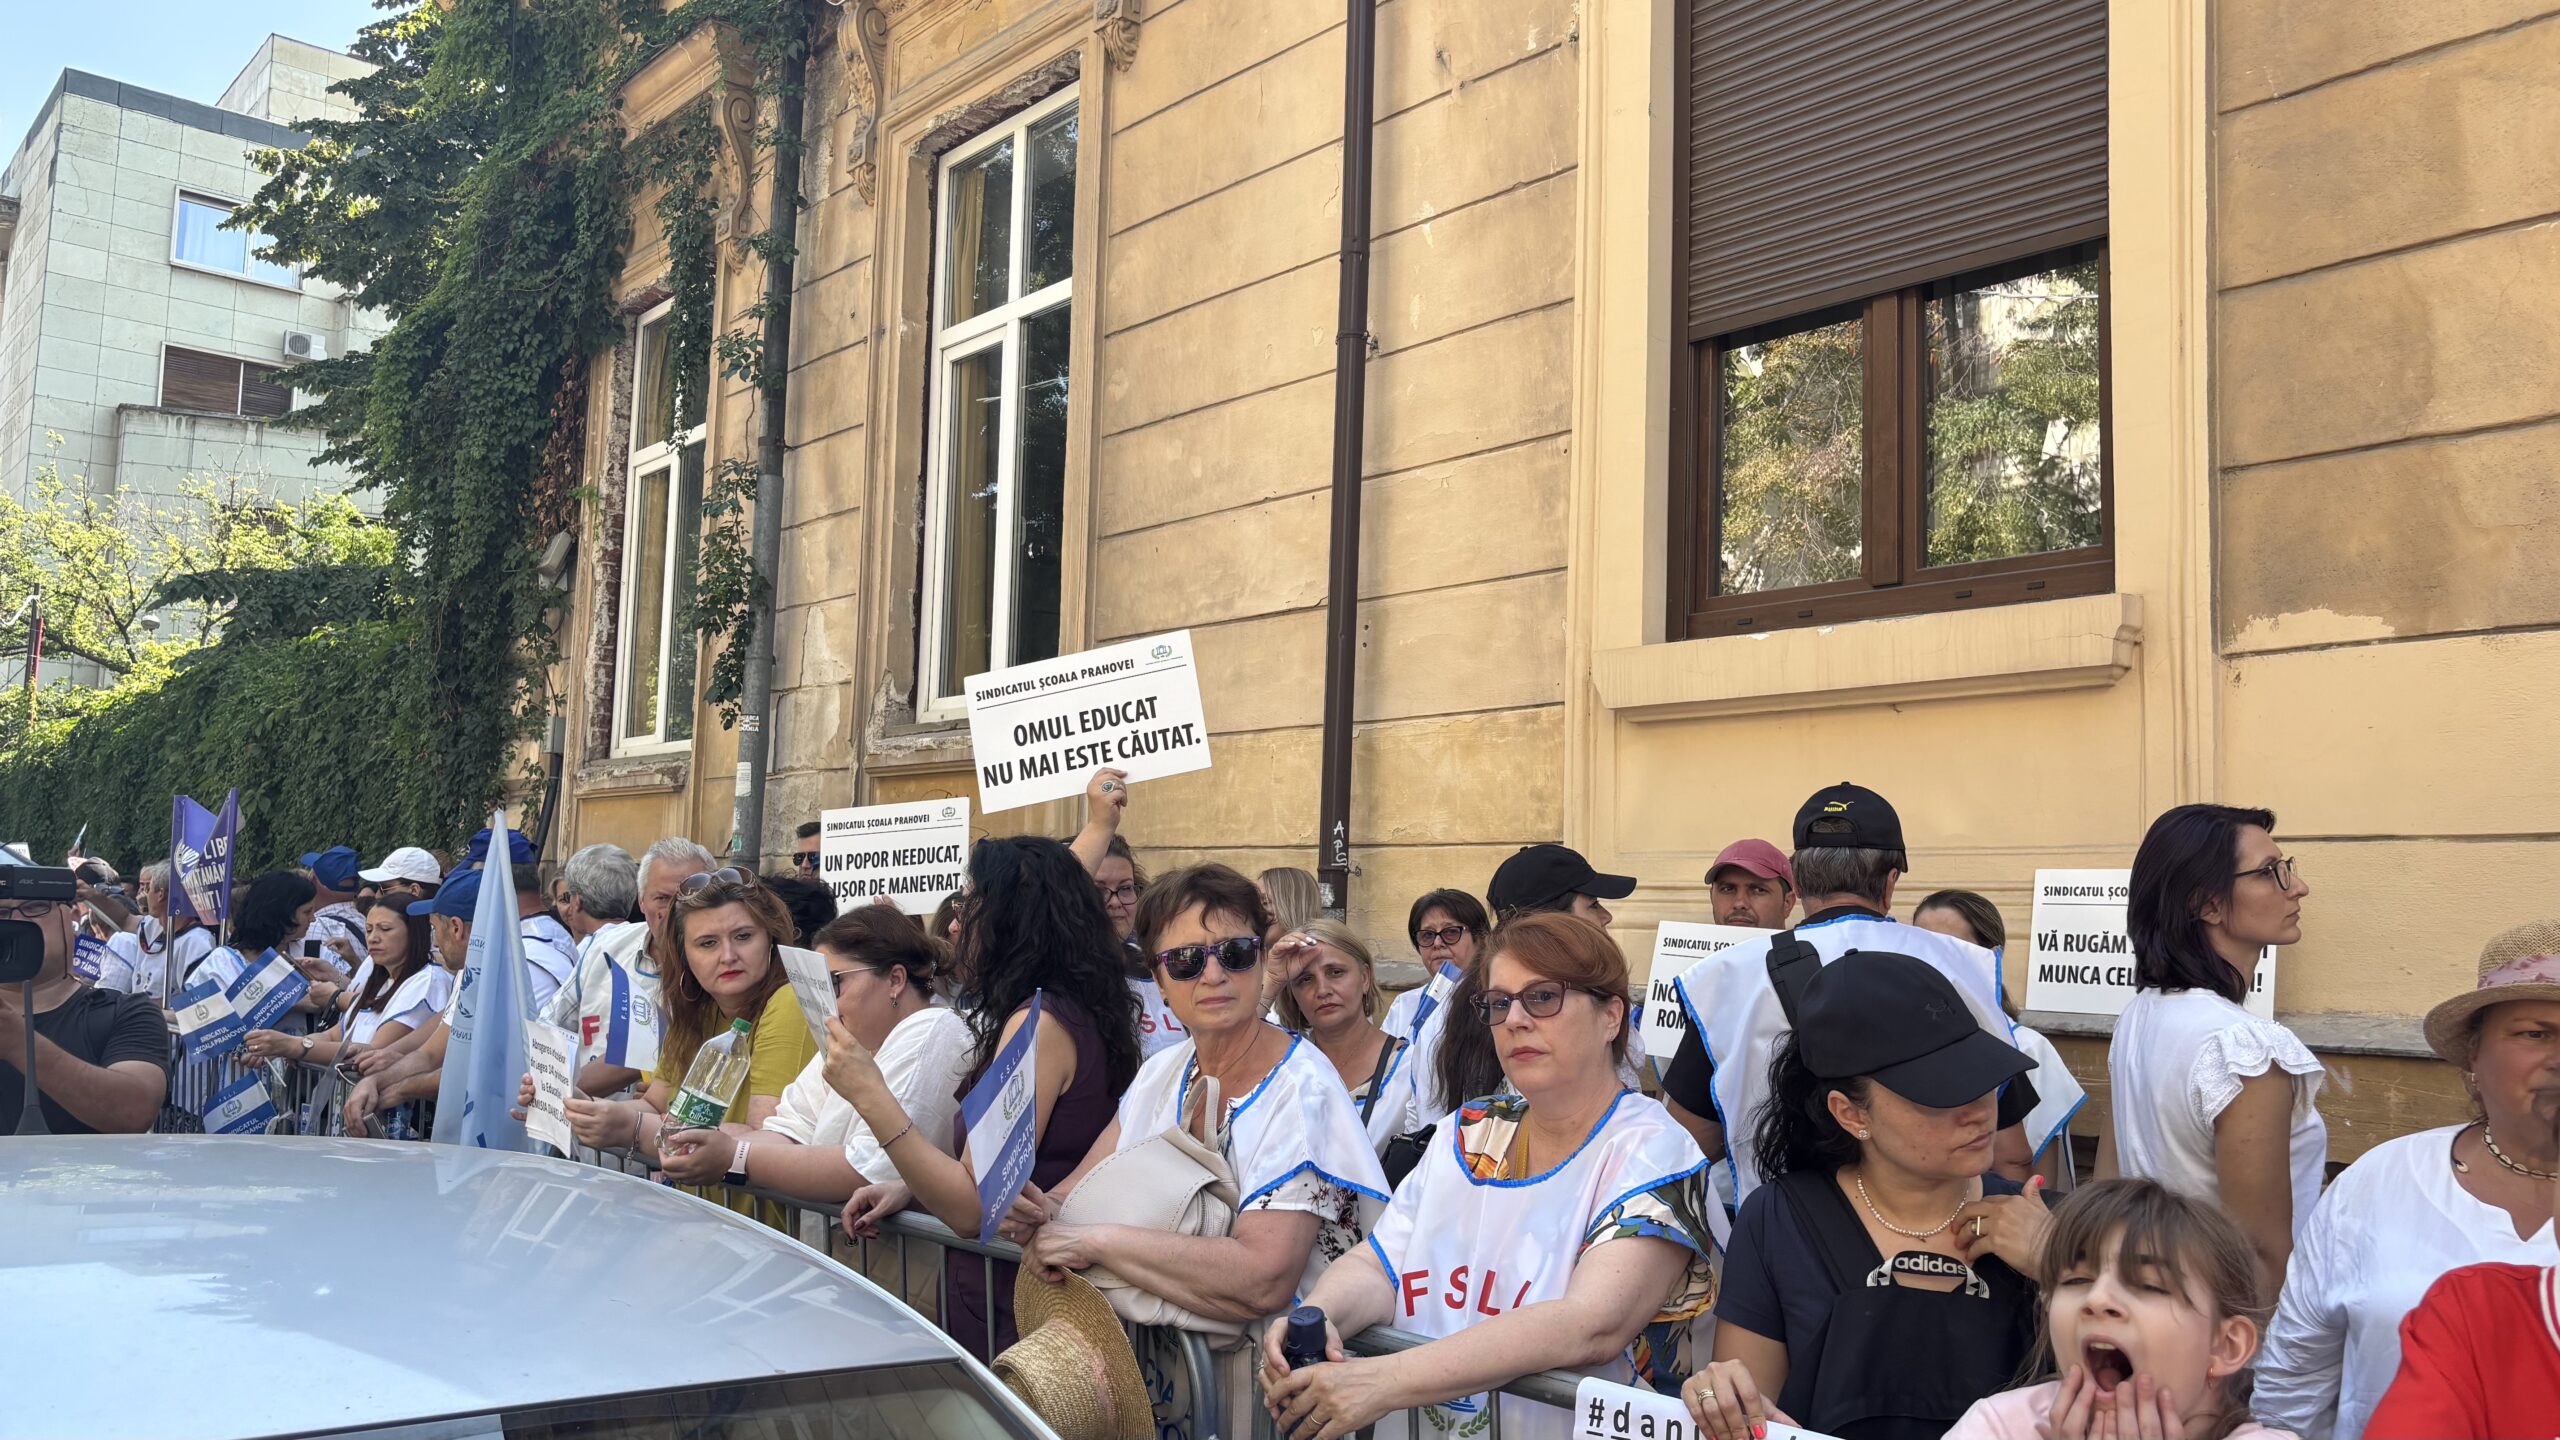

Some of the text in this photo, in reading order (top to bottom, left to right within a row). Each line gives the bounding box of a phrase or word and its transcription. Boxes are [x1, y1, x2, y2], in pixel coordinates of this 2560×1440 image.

[976, 680, 1036, 702] SINDICATUL
[1039, 671, 1078, 691] ȘCOALA
[1081, 658, 1135, 680] PRAHOVEI
[1013, 695, 1158, 747] OMUL EDUCAT
[983, 722, 1201, 789] NU MAI ESTE CĂUTAT.
[827, 814, 930, 832] SINDICATUL ȘCOALA PRAHOVEI
[825, 844, 963, 872] UN POPOR NEEDUCAT,
[833, 880, 866, 903] UȘOR
[869, 878, 886, 896] DE
[2044, 886, 2104, 898] SINDICATUL
[1663, 937, 1711, 951] SINDICATUL
[2038, 929, 2058, 952] VĂ
[2063, 931, 2127, 954] RUGĂM
[2038, 964, 2101, 985] MUNCA
[1652, 979, 1681, 1004] ÎNC
[253, 988, 287, 1021] SINDICATUL
[1895, 1255, 1968, 1275] adidas
